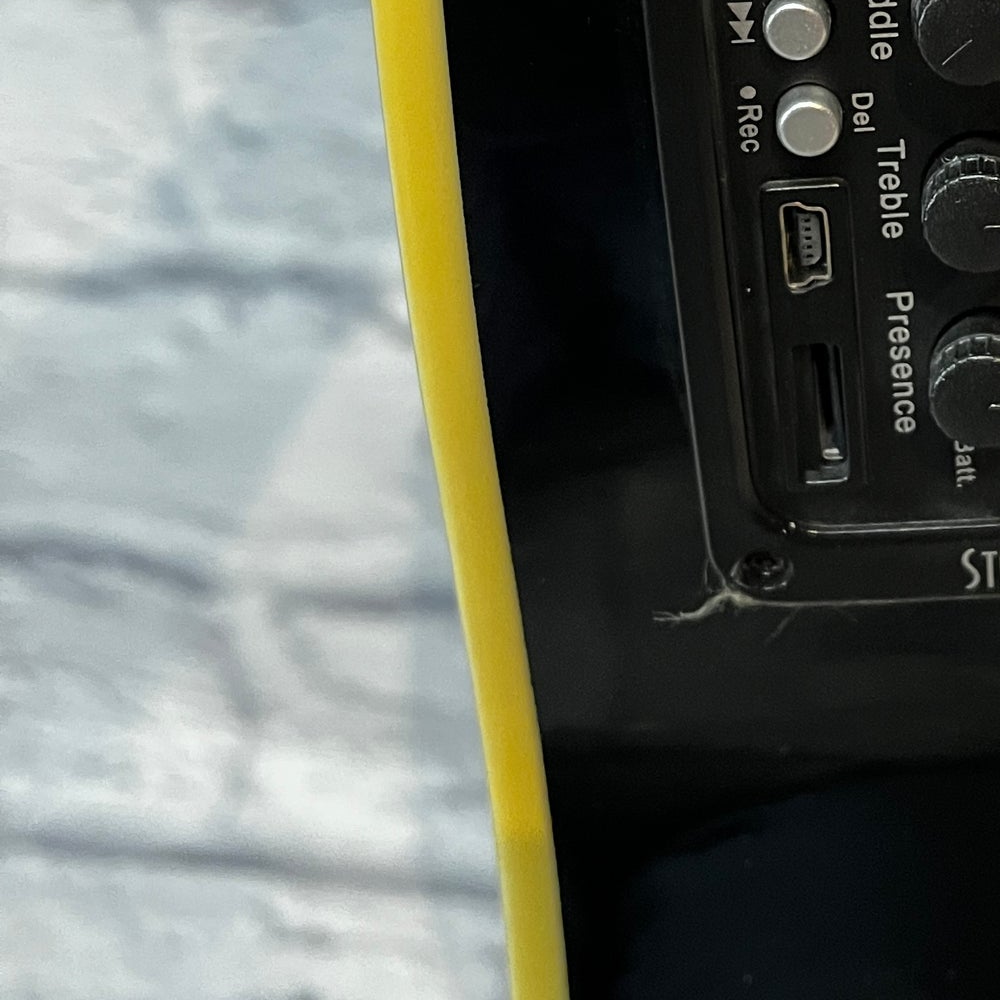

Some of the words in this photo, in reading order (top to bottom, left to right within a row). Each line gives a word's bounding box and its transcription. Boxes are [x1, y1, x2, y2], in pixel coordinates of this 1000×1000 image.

[737, 105, 763, 153] Rec
[851, 92, 876, 133] Del
[876, 138, 910, 239] Treble
[885, 291, 916, 433] Presence
